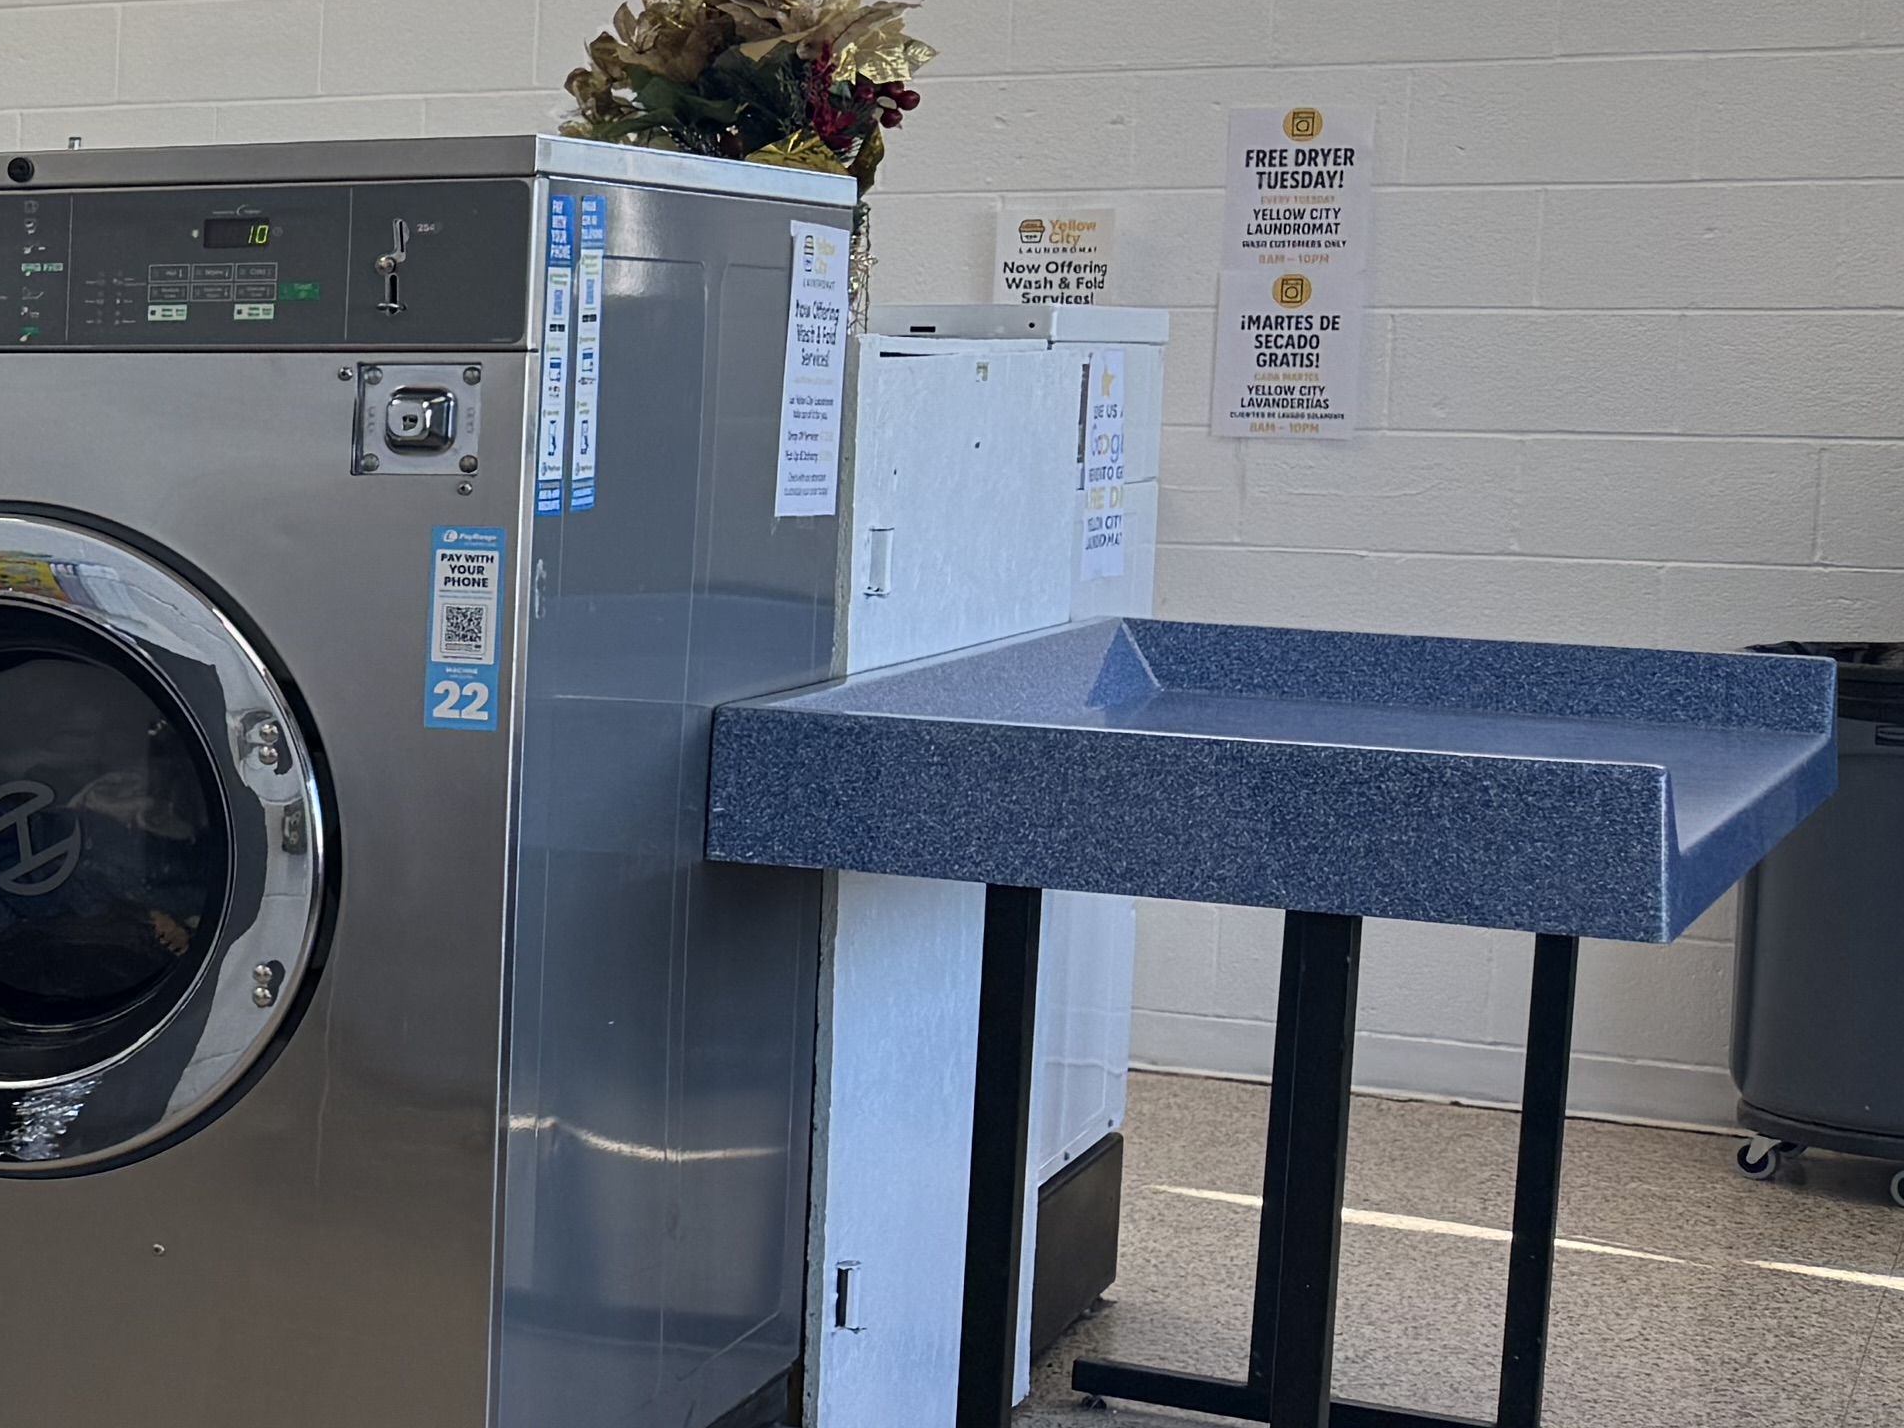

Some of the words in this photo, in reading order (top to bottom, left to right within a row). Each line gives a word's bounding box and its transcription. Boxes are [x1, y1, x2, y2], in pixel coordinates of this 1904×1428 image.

[1245, 149, 1288, 168] FREE
[1294, 148, 1355, 167] DRYER
[1256, 170, 1344, 190] TUESDAY!
[1253, 208, 1306, 221] YELLOW
[1310, 208, 1341, 220] CITY
[249, 224, 269, 244] 10
[1246, 223, 1341, 235] LAUNDROMAT
[1049, 232, 1080, 246] City
[1003, 261, 1041, 274] Now
[1045, 261, 1108, 277] Offering
[1005, 277, 1053, 290] Wash
[1058, 277, 1071, 290] &
[1076, 277, 1105, 290] Fold
[1021, 292, 1094, 305] Services!
[1241, 315, 1313, 331] ¡MARTES
[1320, 315, 1341, 331] DE
[1254, 334, 1320, 350] SECADO
[1256, 352, 1320, 369] GRATIS!
[1247, 385, 1295, 396] YELLOW
[1299, 385, 1326, 396] CITY
[441, 553, 461, 563] PAY
[464, 554, 494, 564] WITH
[449, 564, 485, 575] YOUR
[444, 576, 489, 588] PHONE
[433, 681, 489, 720] 22
